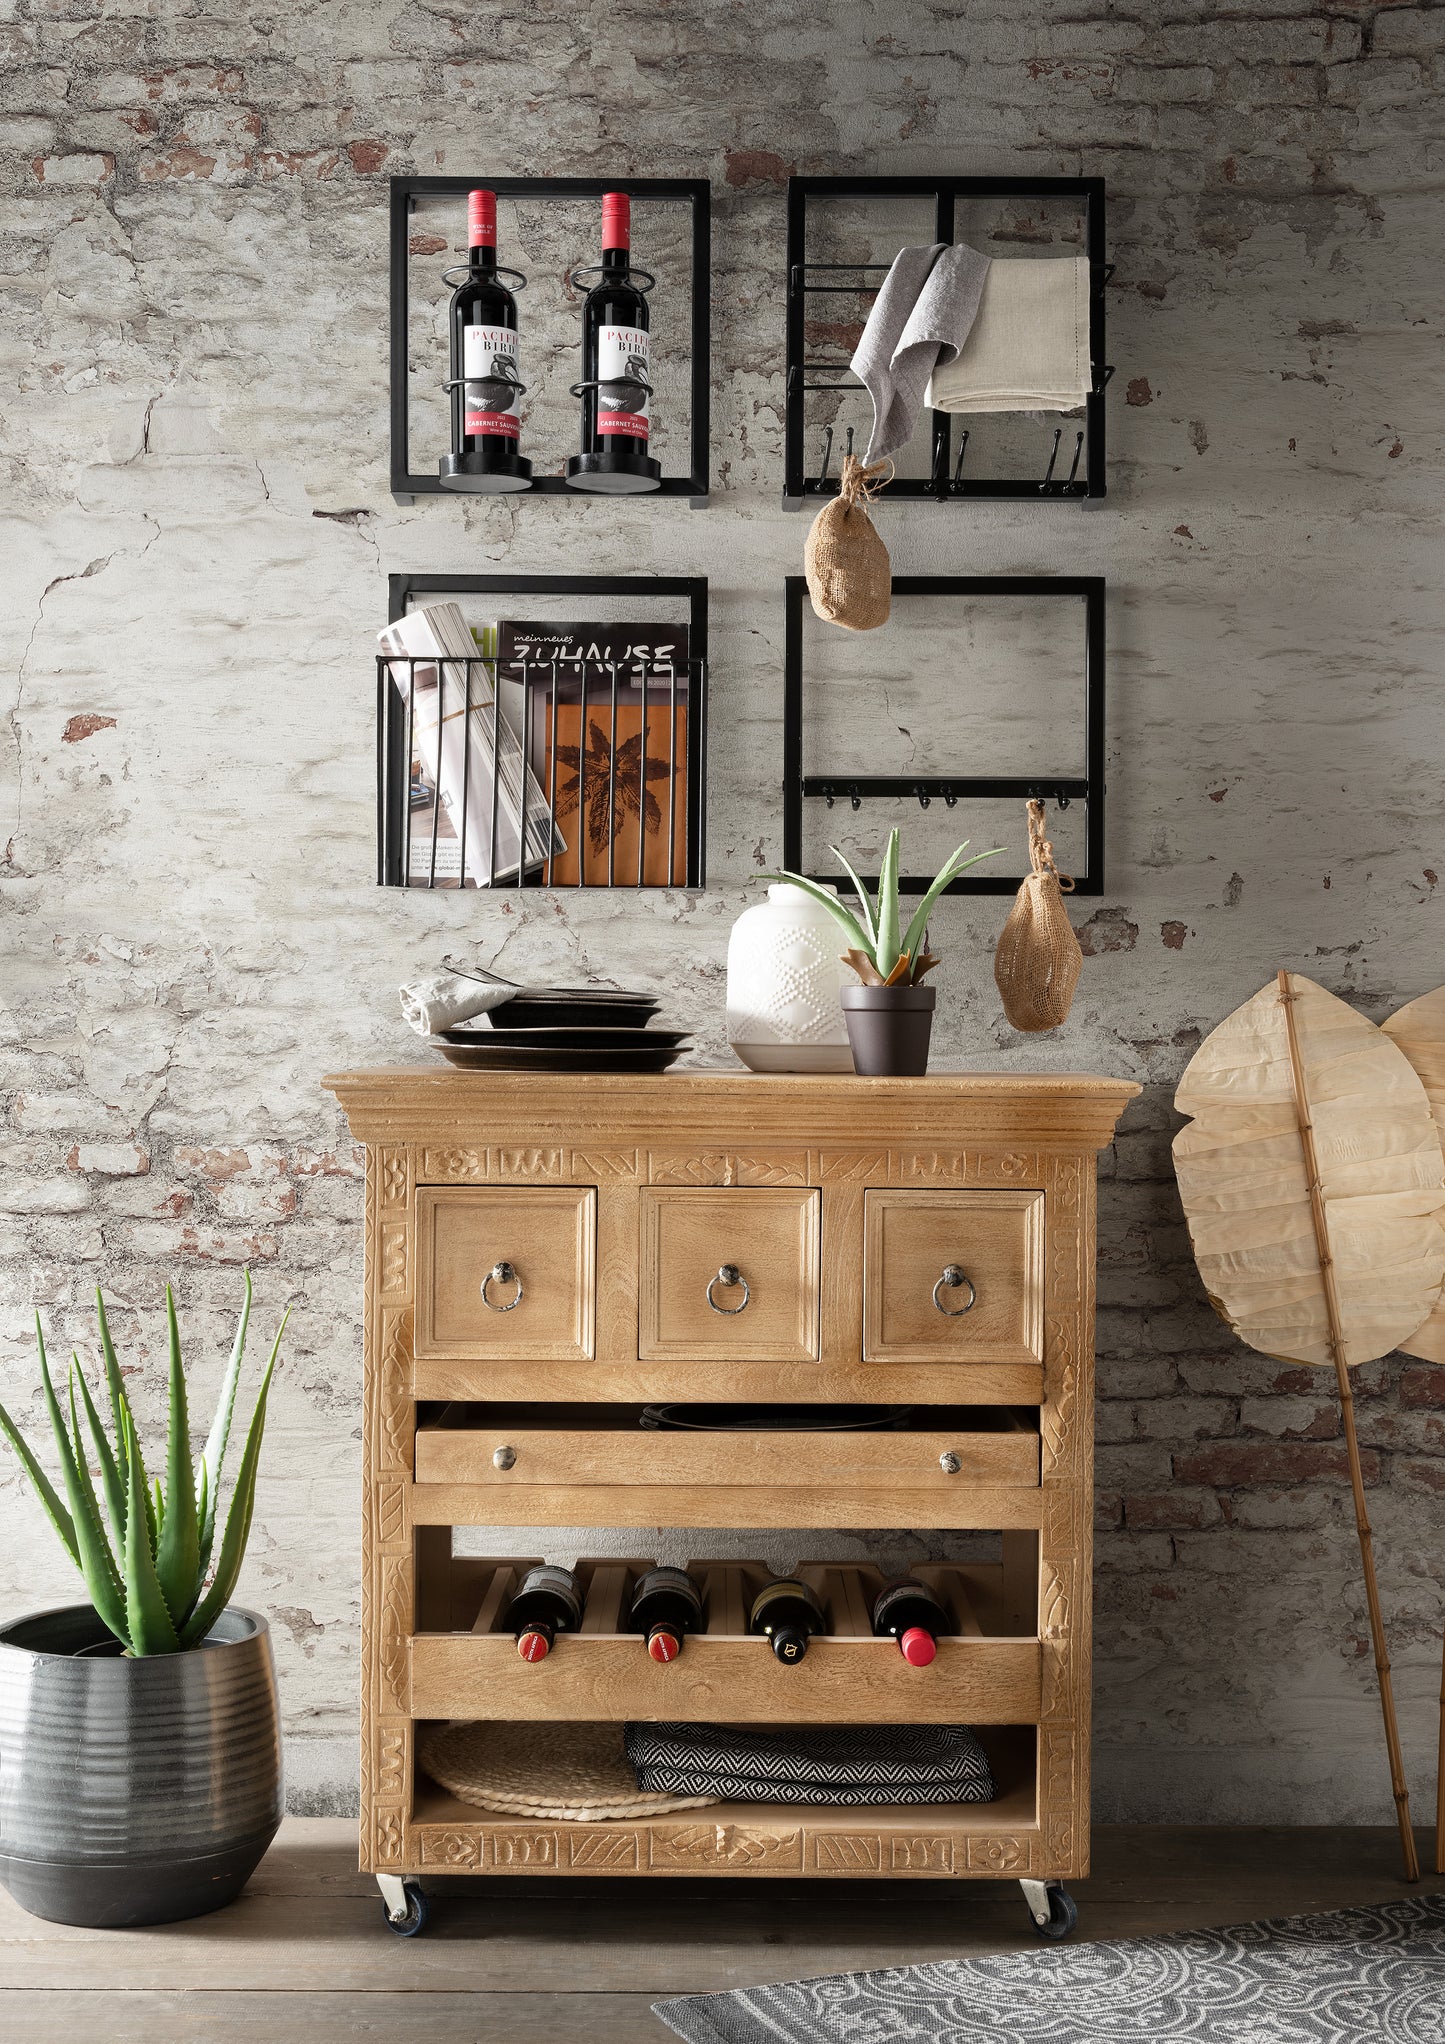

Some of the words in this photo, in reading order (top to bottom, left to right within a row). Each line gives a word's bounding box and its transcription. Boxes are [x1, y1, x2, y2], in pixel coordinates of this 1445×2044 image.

[484, 341, 515, 354] BIRD
[619, 341, 647, 356] BIRD
[600, 420, 631, 428] CABERNET
[509, 642, 676, 673] ZUHAUSE
